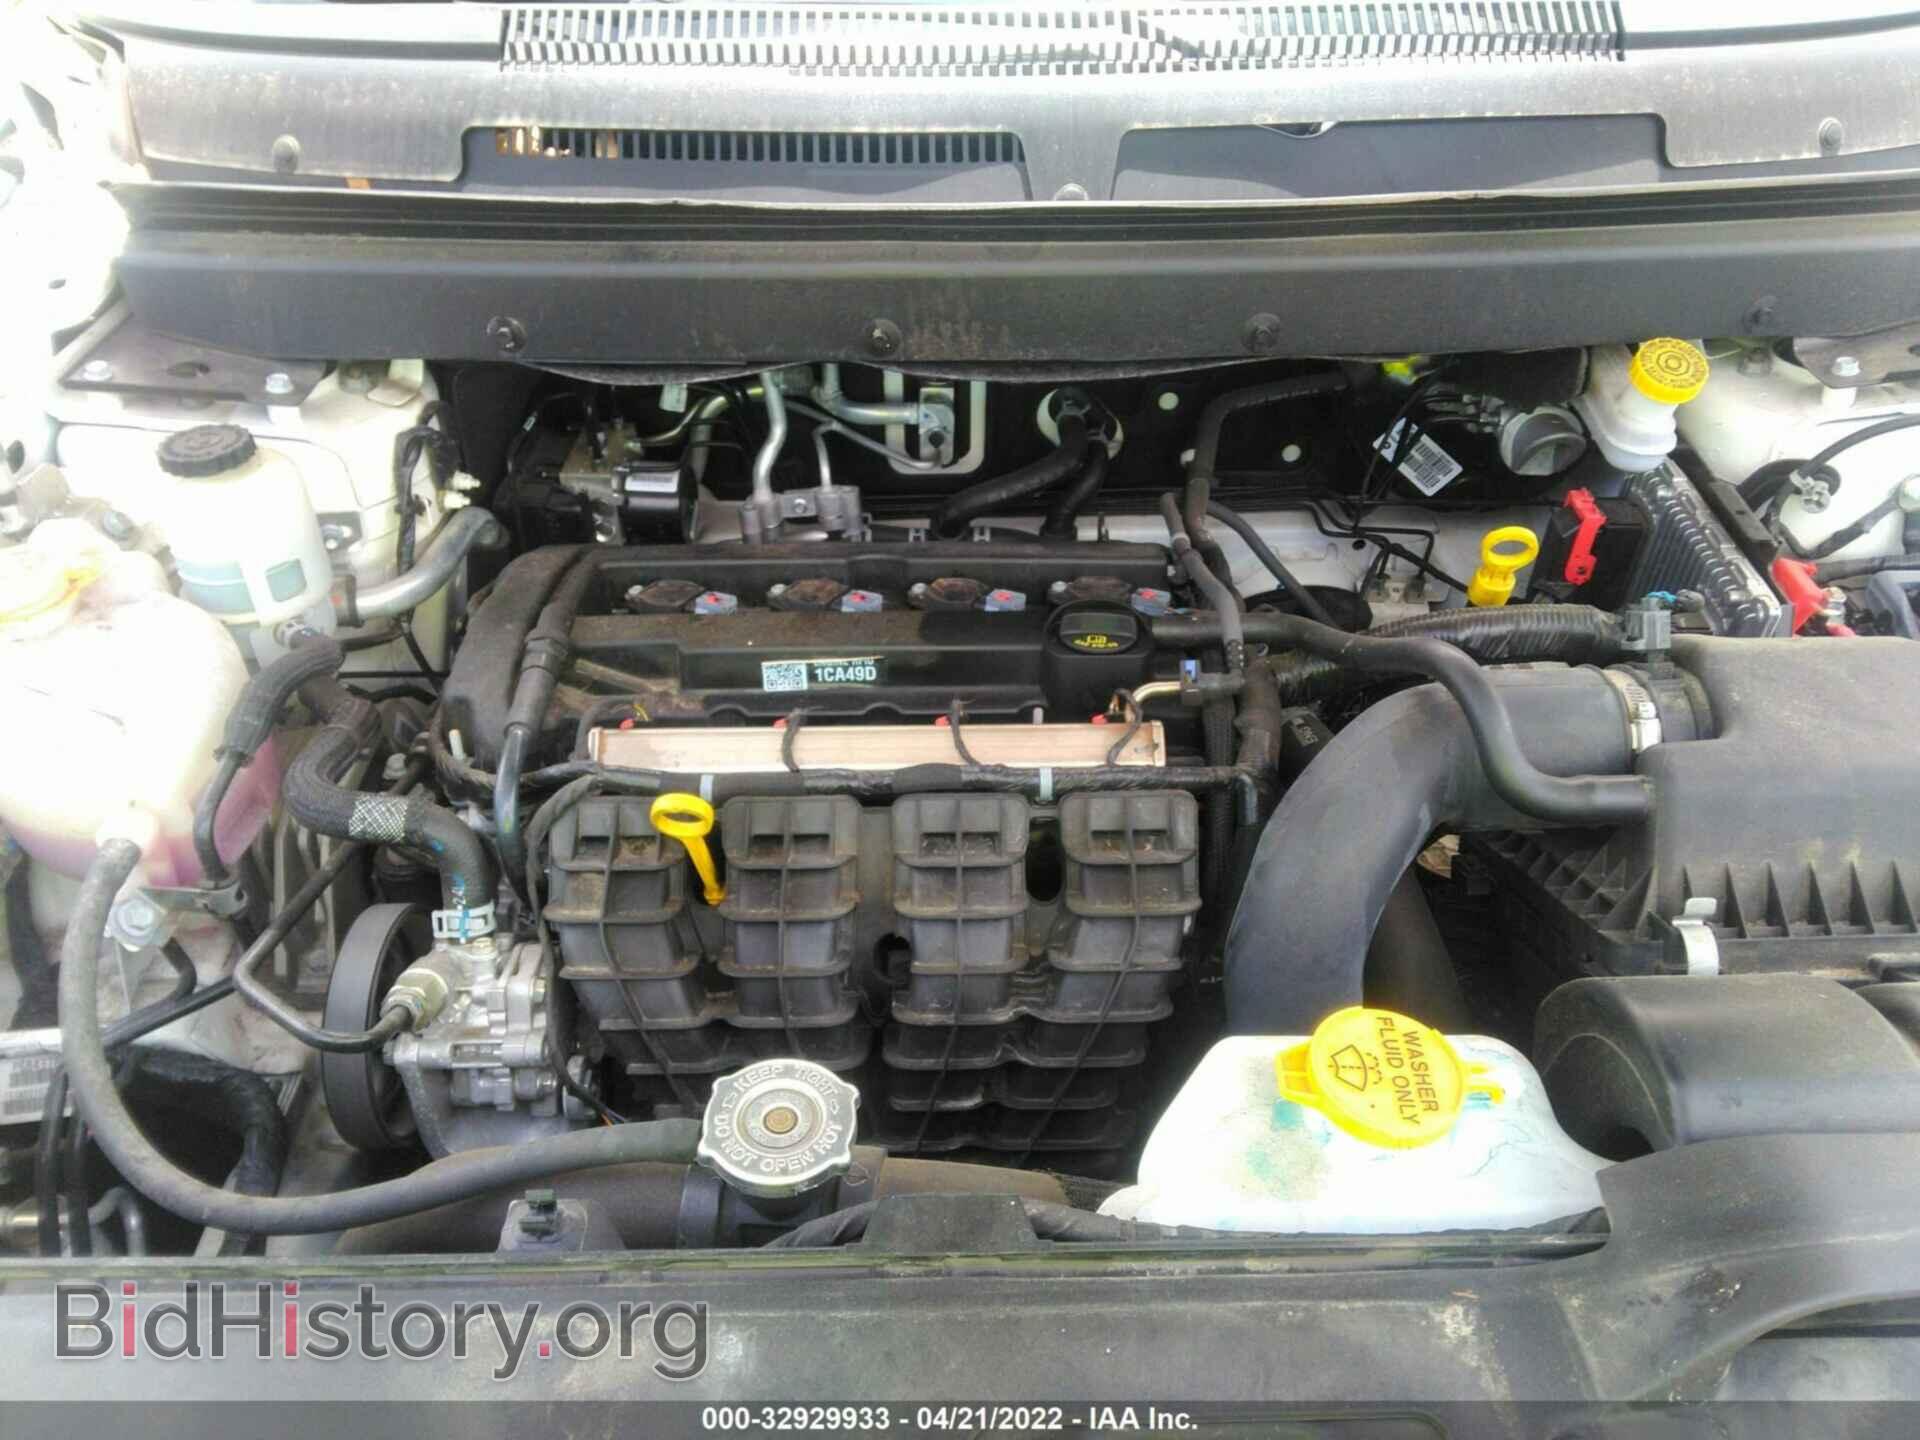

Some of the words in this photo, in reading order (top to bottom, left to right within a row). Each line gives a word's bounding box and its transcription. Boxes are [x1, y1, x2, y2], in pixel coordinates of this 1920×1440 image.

[814, 666, 877, 683] 1CA49D
[733, 1064, 784, 1093] KEEP
[1376, 1016, 1405, 1070] FLUID
[1391, 1075, 1421, 1126] ONLY
[1402, 1030, 1440, 1113] WASHER
[714, 1113, 731, 1138] DO
[813, 1123, 843, 1155] HOT
[720, 1137, 759, 1168] NOT
[759, 1150, 815, 1172] OPEN
